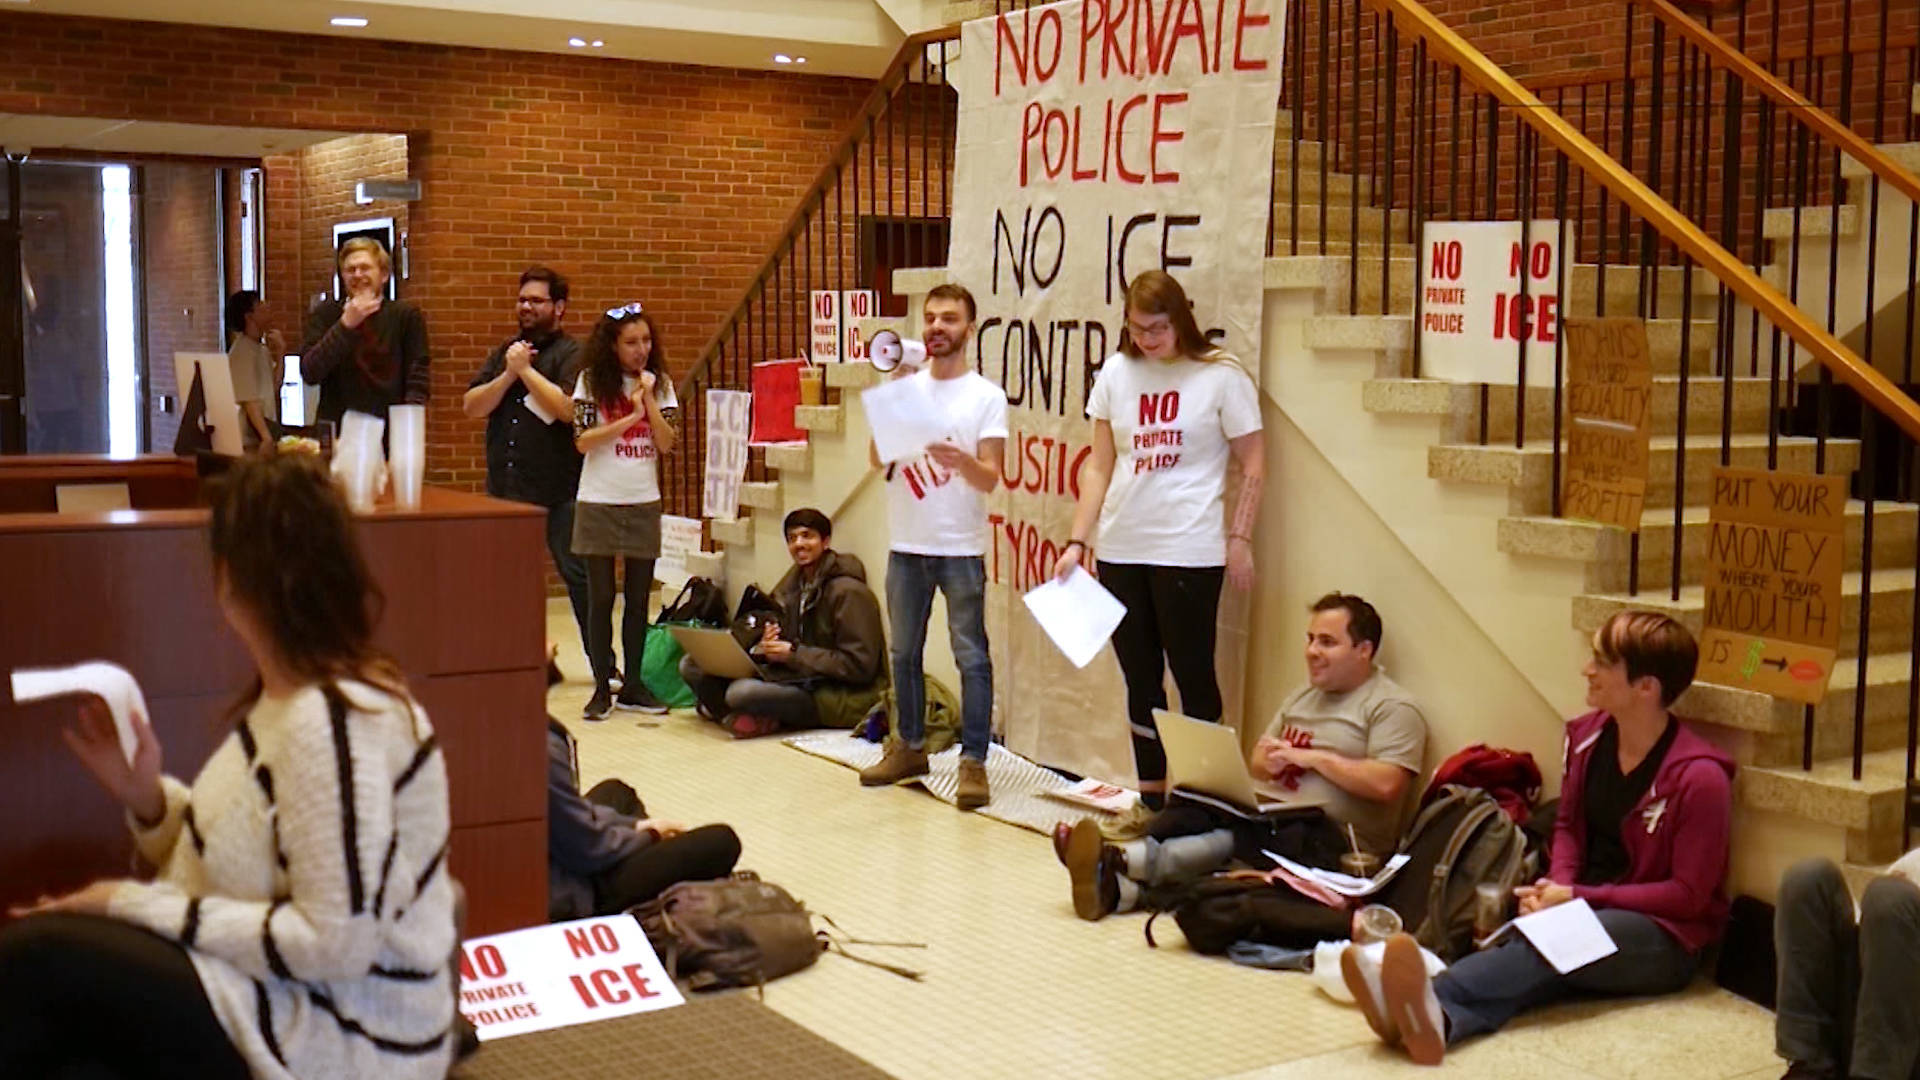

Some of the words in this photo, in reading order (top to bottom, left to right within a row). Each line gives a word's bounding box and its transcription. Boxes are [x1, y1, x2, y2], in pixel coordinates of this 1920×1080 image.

[994, 8, 1063, 97] NO
[1079, 0, 1271, 84] PRIVATE
[1020, 92, 1188, 187] POLICE
[992, 205, 1065, 297] NO
[1105, 213, 1201, 308] ICE
[1432, 240, 1463, 281] NO
[1509, 241, 1552, 280] NO
[815, 293, 833, 320] NO
[851, 292, 867, 318] NO
[1426, 287, 1466, 305] PRIVATE
[1425, 313, 1464, 334] POLICE
[1493, 293, 1557, 343] ICE
[977, 317, 1226, 420] CONTR
[1139, 391, 1180, 426] NO
[1001, 430, 1092, 502] USTIC
[1566, 479, 1642, 525] PROFIT
[1715, 476, 1755, 507] PUT
[1768, 480, 1832, 517] YOUR
[988, 514, 1097, 593] TYRO
[1709, 522, 1828, 576] MONEY
[1719, 569, 1770, 588] WHERE
[1781, 578, 1823, 599] YOUR
[1707, 588, 1828, 639] MOUTH
[1709, 638, 1733, 664] IS
[563, 923, 620, 960] NO
[460, 981, 529, 1005] RIVATE
[570, 963, 661, 1009] ICE
